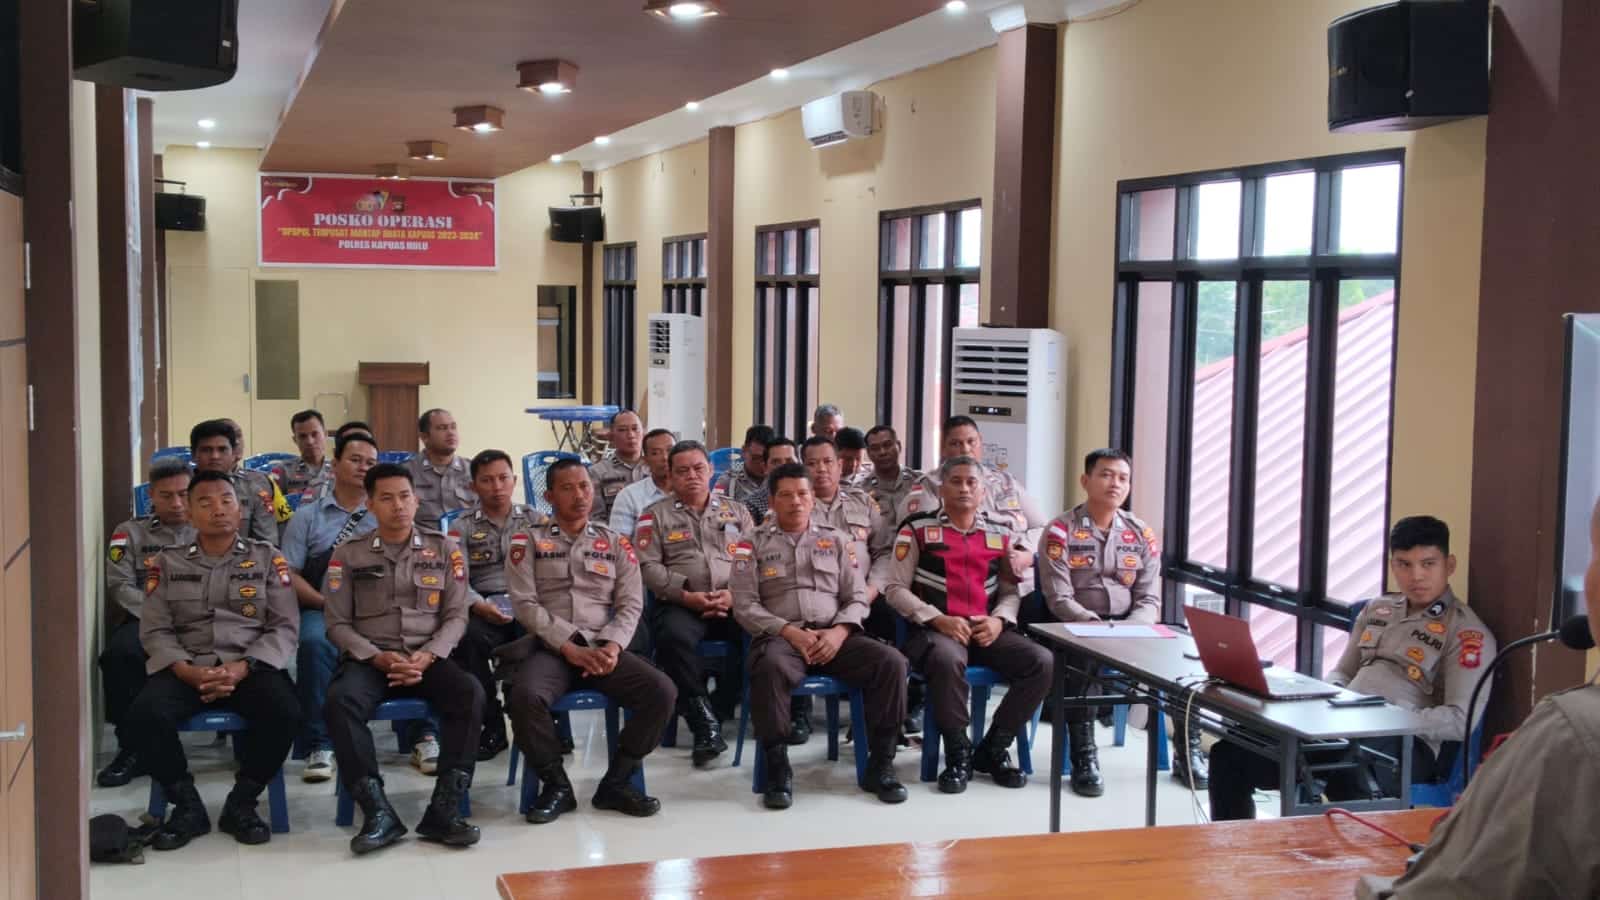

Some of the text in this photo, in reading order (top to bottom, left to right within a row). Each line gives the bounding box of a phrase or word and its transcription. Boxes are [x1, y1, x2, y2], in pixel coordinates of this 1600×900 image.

[313, 213, 452, 229] POSKO OPERASI
[338, 239, 429, 251] POLRES KAPUAS HULU
[584, 551, 616, 562] POLRI
[414, 561, 445, 571] POLRI
[230, 572, 263, 582] POLRI
[1411, 629, 1443, 651] POLRI
